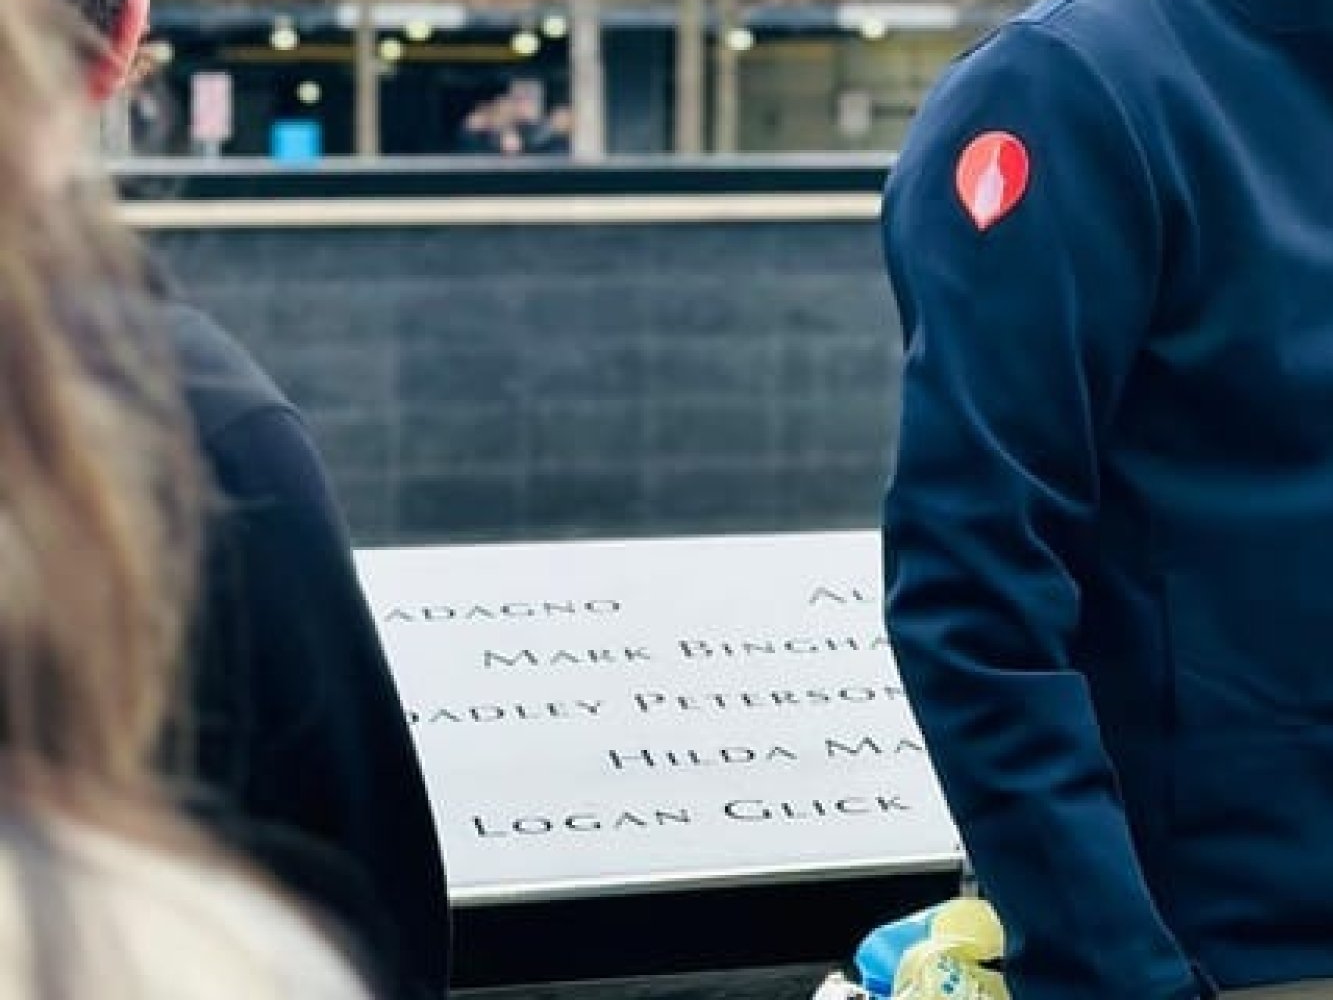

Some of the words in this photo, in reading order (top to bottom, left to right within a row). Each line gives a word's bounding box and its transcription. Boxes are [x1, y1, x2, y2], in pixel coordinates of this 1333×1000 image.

[484, 646, 651, 668] MARK
[609, 747, 798, 769] HILDA
[473, 809, 692, 837] LOGAN
[724, 796, 912, 821] GLICK
